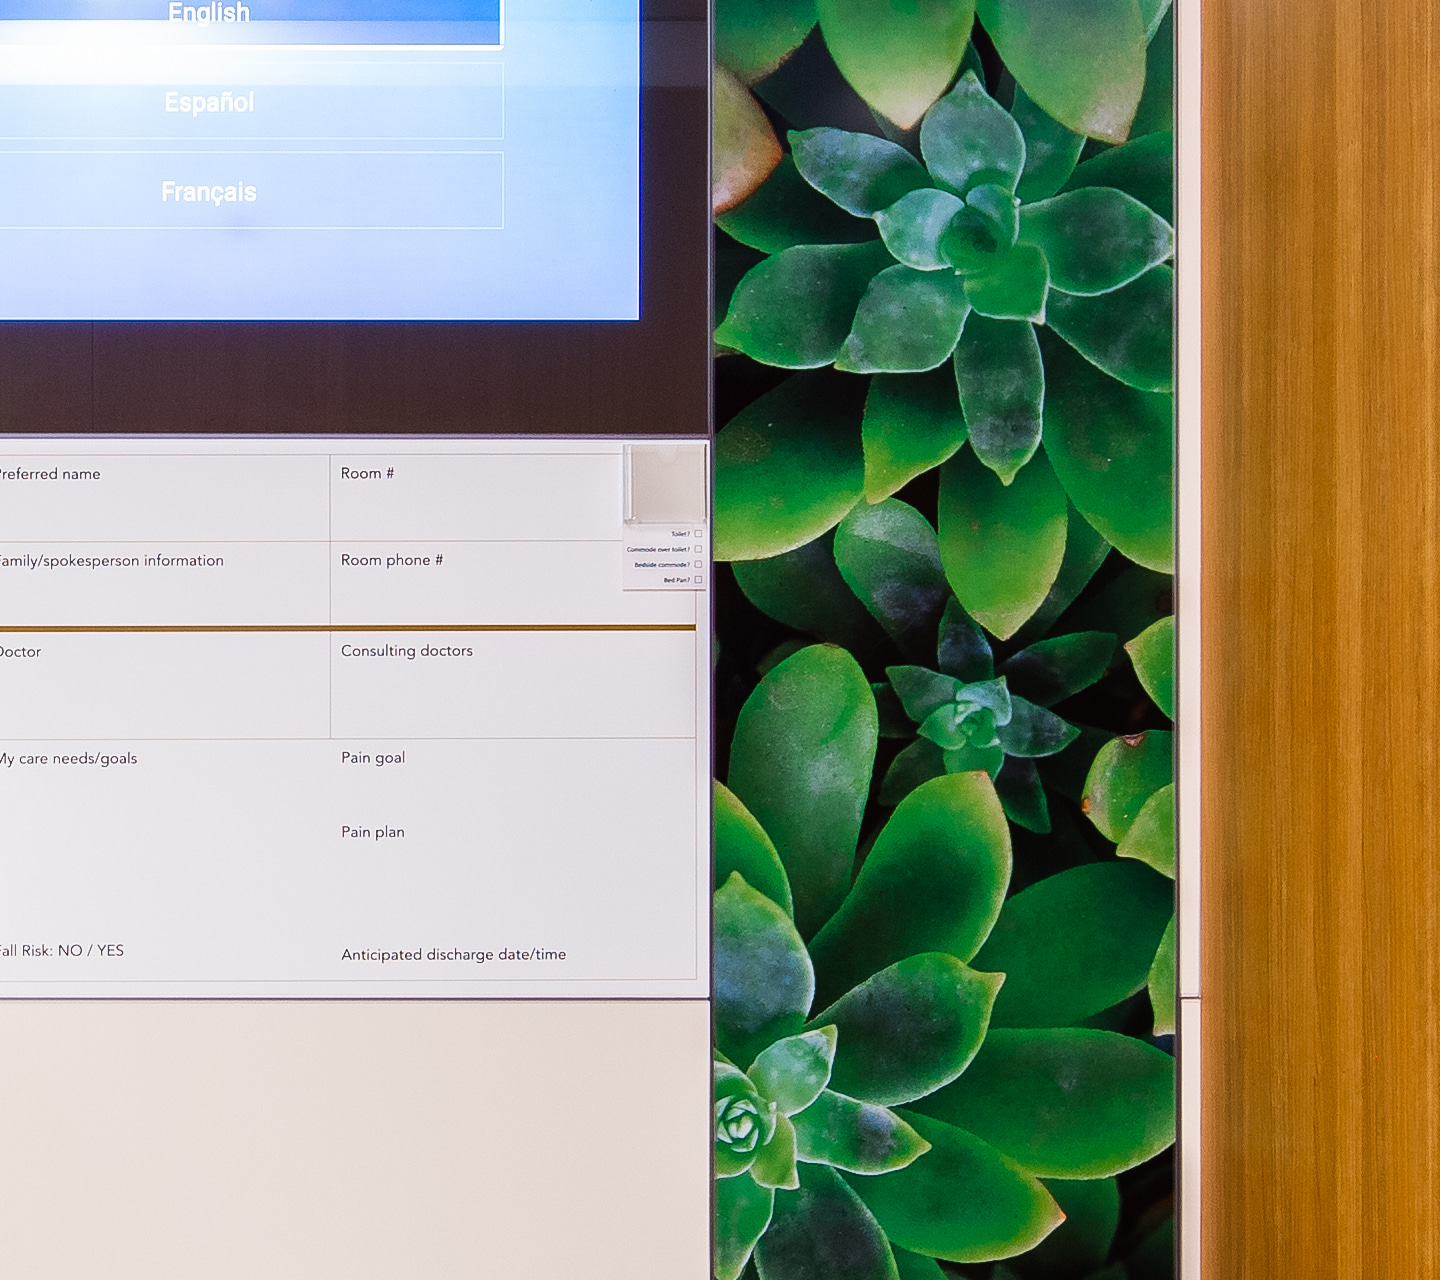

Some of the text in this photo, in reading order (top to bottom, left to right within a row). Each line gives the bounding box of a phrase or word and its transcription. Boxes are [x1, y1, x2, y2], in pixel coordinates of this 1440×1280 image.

[168, 0, 251, 28] English
[164, 90, 255, 118] Español
[161, 180, 258, 207] Français
[62, 470, 101, 480] name
[341, 466, 395, 480] Room #
[144, 552, 224, 567] information
[341, 552, 444, 570] Room phone #
[341, 643, 474, 661] Consulting doctors
[19, 755, 49, 765] care
[52, 751, 138, 768] needs/goals
[341, 750, 406, 768] Pain goal
[341, 824, 405, 842] Pain plan
[22, 943, 54, 957] Risk:
[58, 943, 83, 957] NO
[86, 943, 94, 957] /
[96, 943, 125, 957] YES
[341, 947, 567, 965] Anticipated discharge date/time
